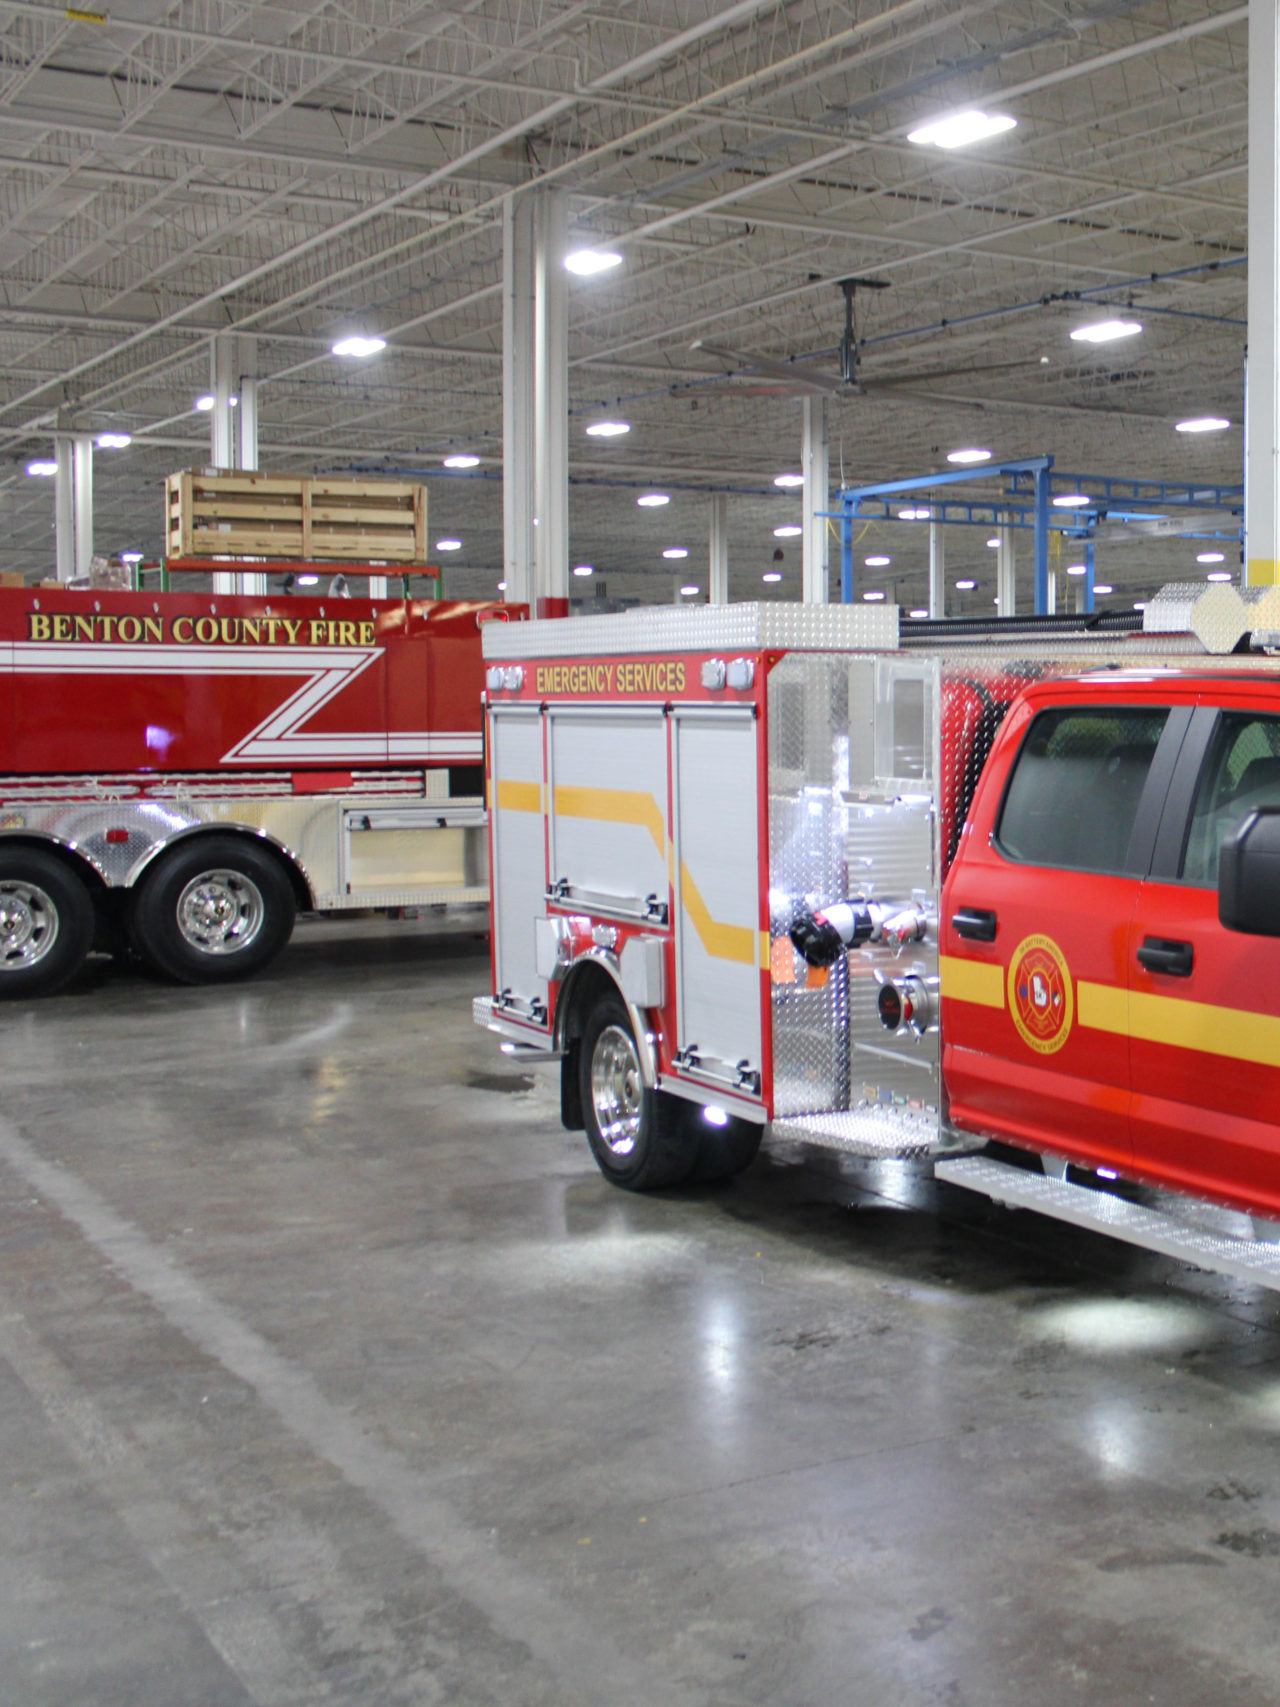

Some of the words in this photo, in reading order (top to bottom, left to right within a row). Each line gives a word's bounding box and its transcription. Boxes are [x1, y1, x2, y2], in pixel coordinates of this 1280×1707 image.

[27, 613, 165, 642] BENTON
[172, 616, 303, 644] COUNTY
[308, 619, 377, 646] FIRE
[536, 664, 613, 694] EMERGENCY
[616, 661, 686, 692] SERVICES
